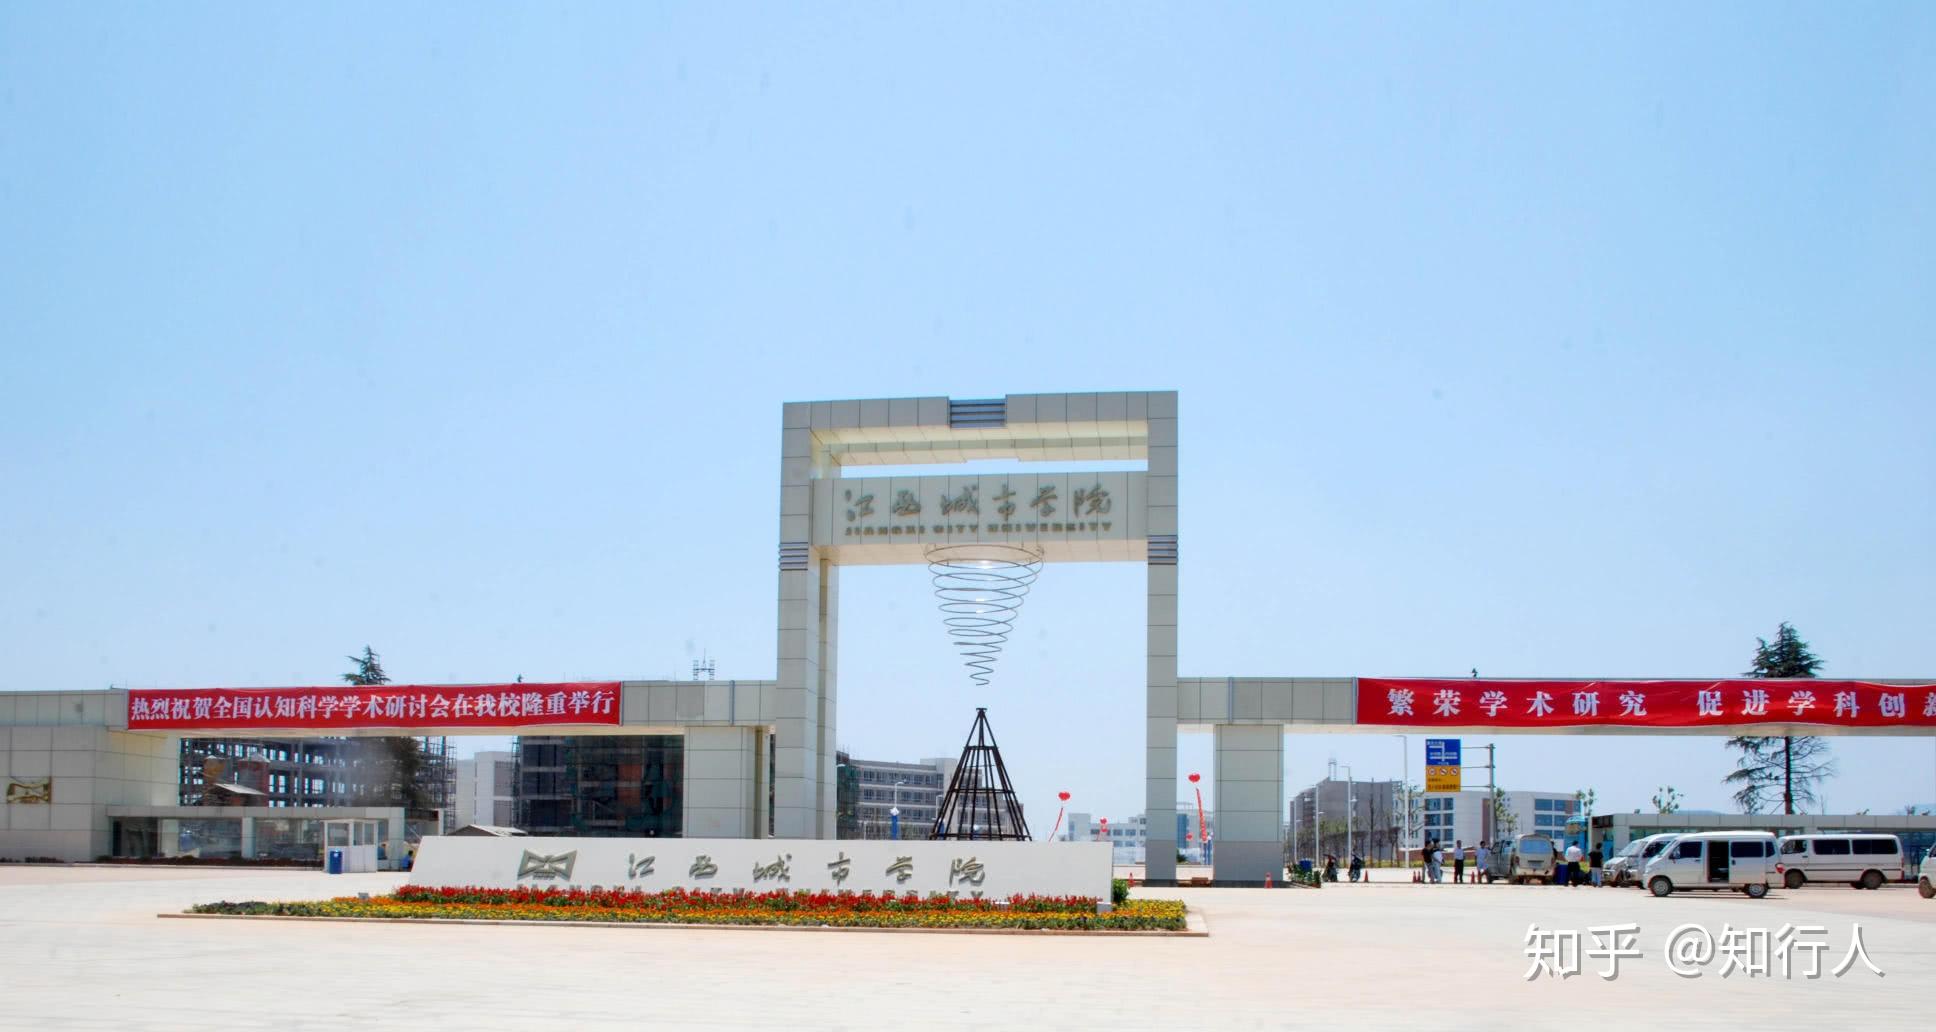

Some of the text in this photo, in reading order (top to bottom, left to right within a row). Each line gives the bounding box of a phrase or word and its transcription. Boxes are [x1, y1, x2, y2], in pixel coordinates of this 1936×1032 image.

[845, 484, 1112, 521] 江西城市学院
[933, 524, 978, 534] CITY
[987, 521, 1112, 533] UNIVERSITY
[130, 690, 614, 723] 热烈祝贺全国认知科学学术研讨会在我校隆重举行
[1387, 688, 1647, 718] 繁荣学术研究
[627, 852, 985, 887] 江西城市学院
